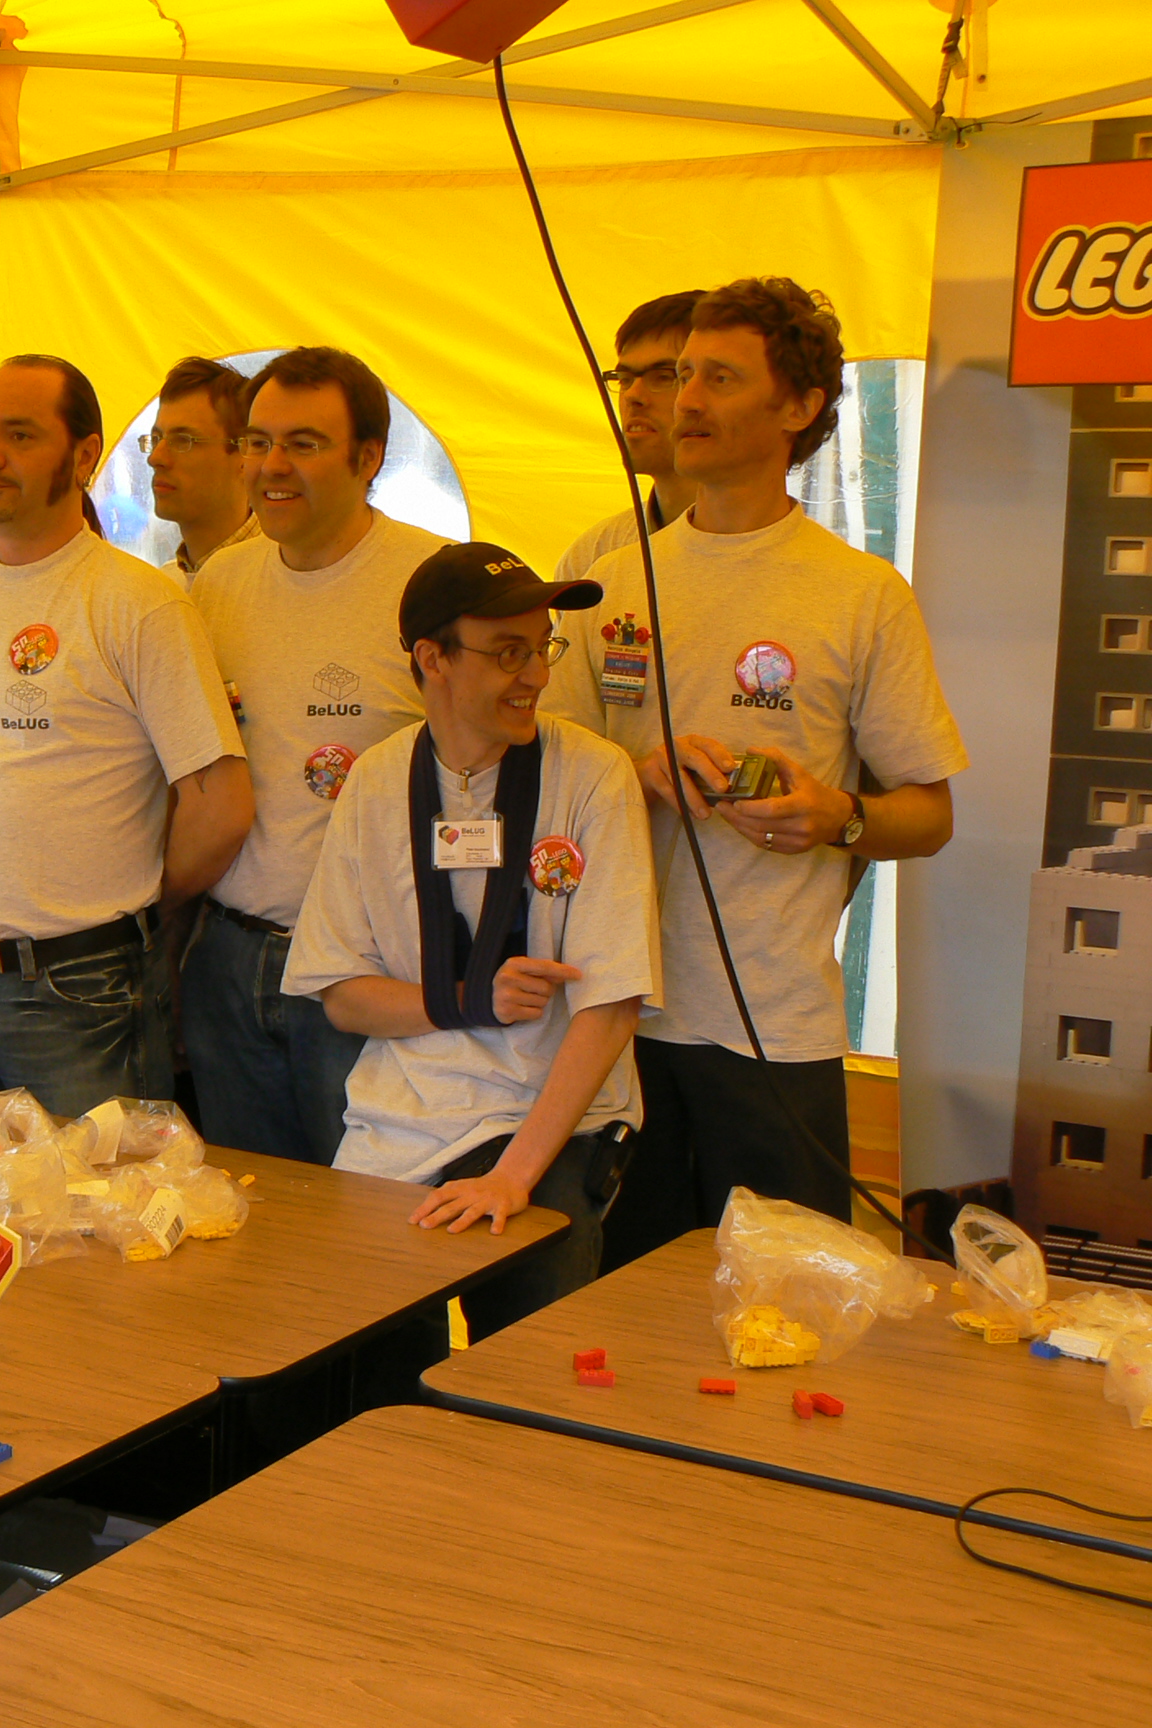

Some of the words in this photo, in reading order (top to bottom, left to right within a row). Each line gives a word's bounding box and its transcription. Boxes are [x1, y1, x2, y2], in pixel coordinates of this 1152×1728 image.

[1028, 227, 1152, 316] LEG
[484, 557, 525, 576] BeL
[307, 704, 362, 717] BeLUG
[731, 694, 794, 712] BeLUG
[1, 718, 50, 730] BeLUG
[461, 827, 486, 835] BeLUG
